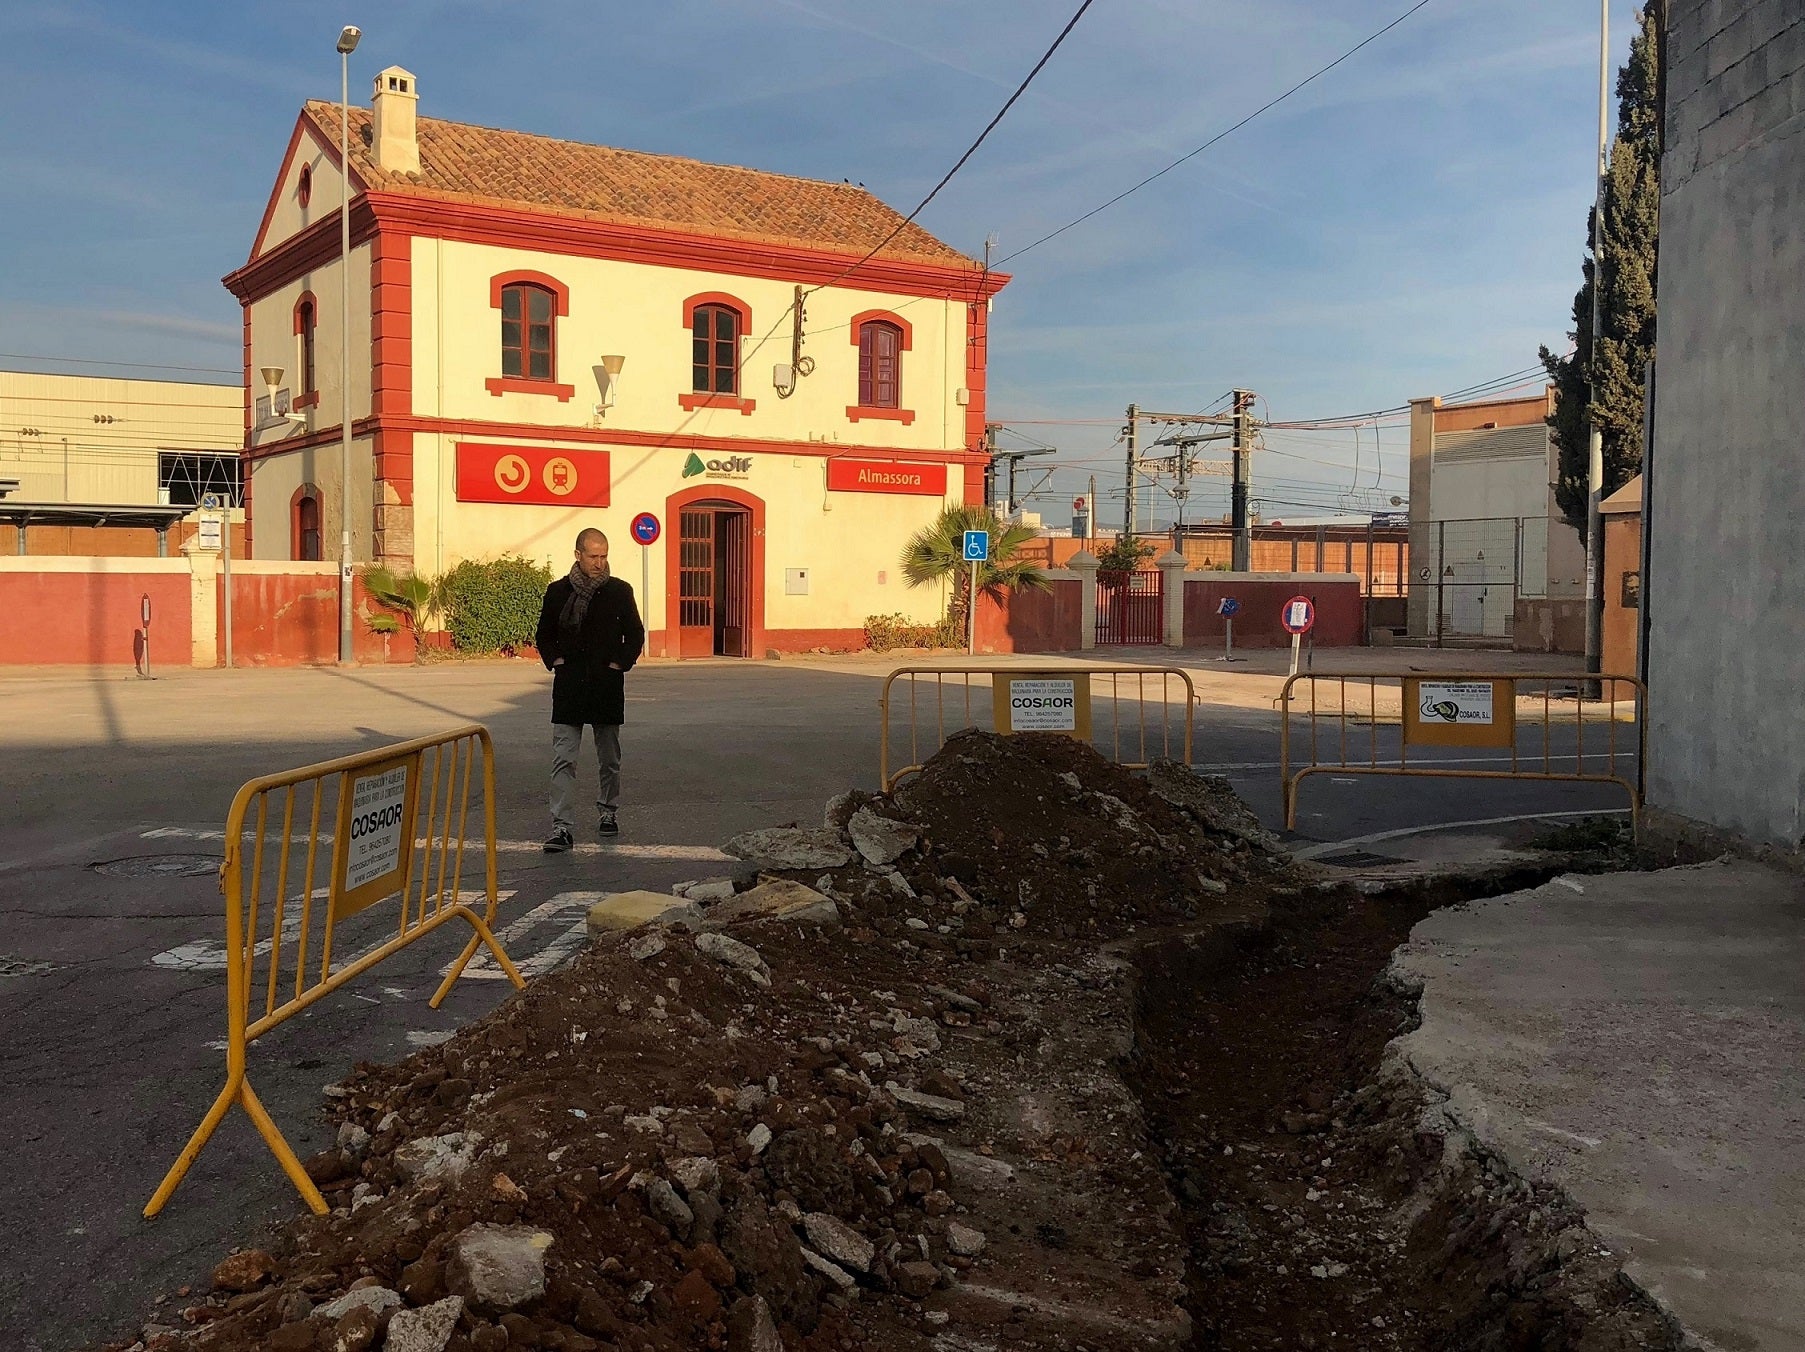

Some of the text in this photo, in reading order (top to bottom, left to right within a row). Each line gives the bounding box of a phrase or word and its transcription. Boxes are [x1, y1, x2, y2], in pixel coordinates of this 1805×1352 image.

[706, 455, 754, 473] adif
[858, 468, 921, 486] Almassora
[1012, 698, 1073, 708] COSAOR
[1482, 711, 1491, 719] S.L.
[351, 803, 403, 840] COSAOR
